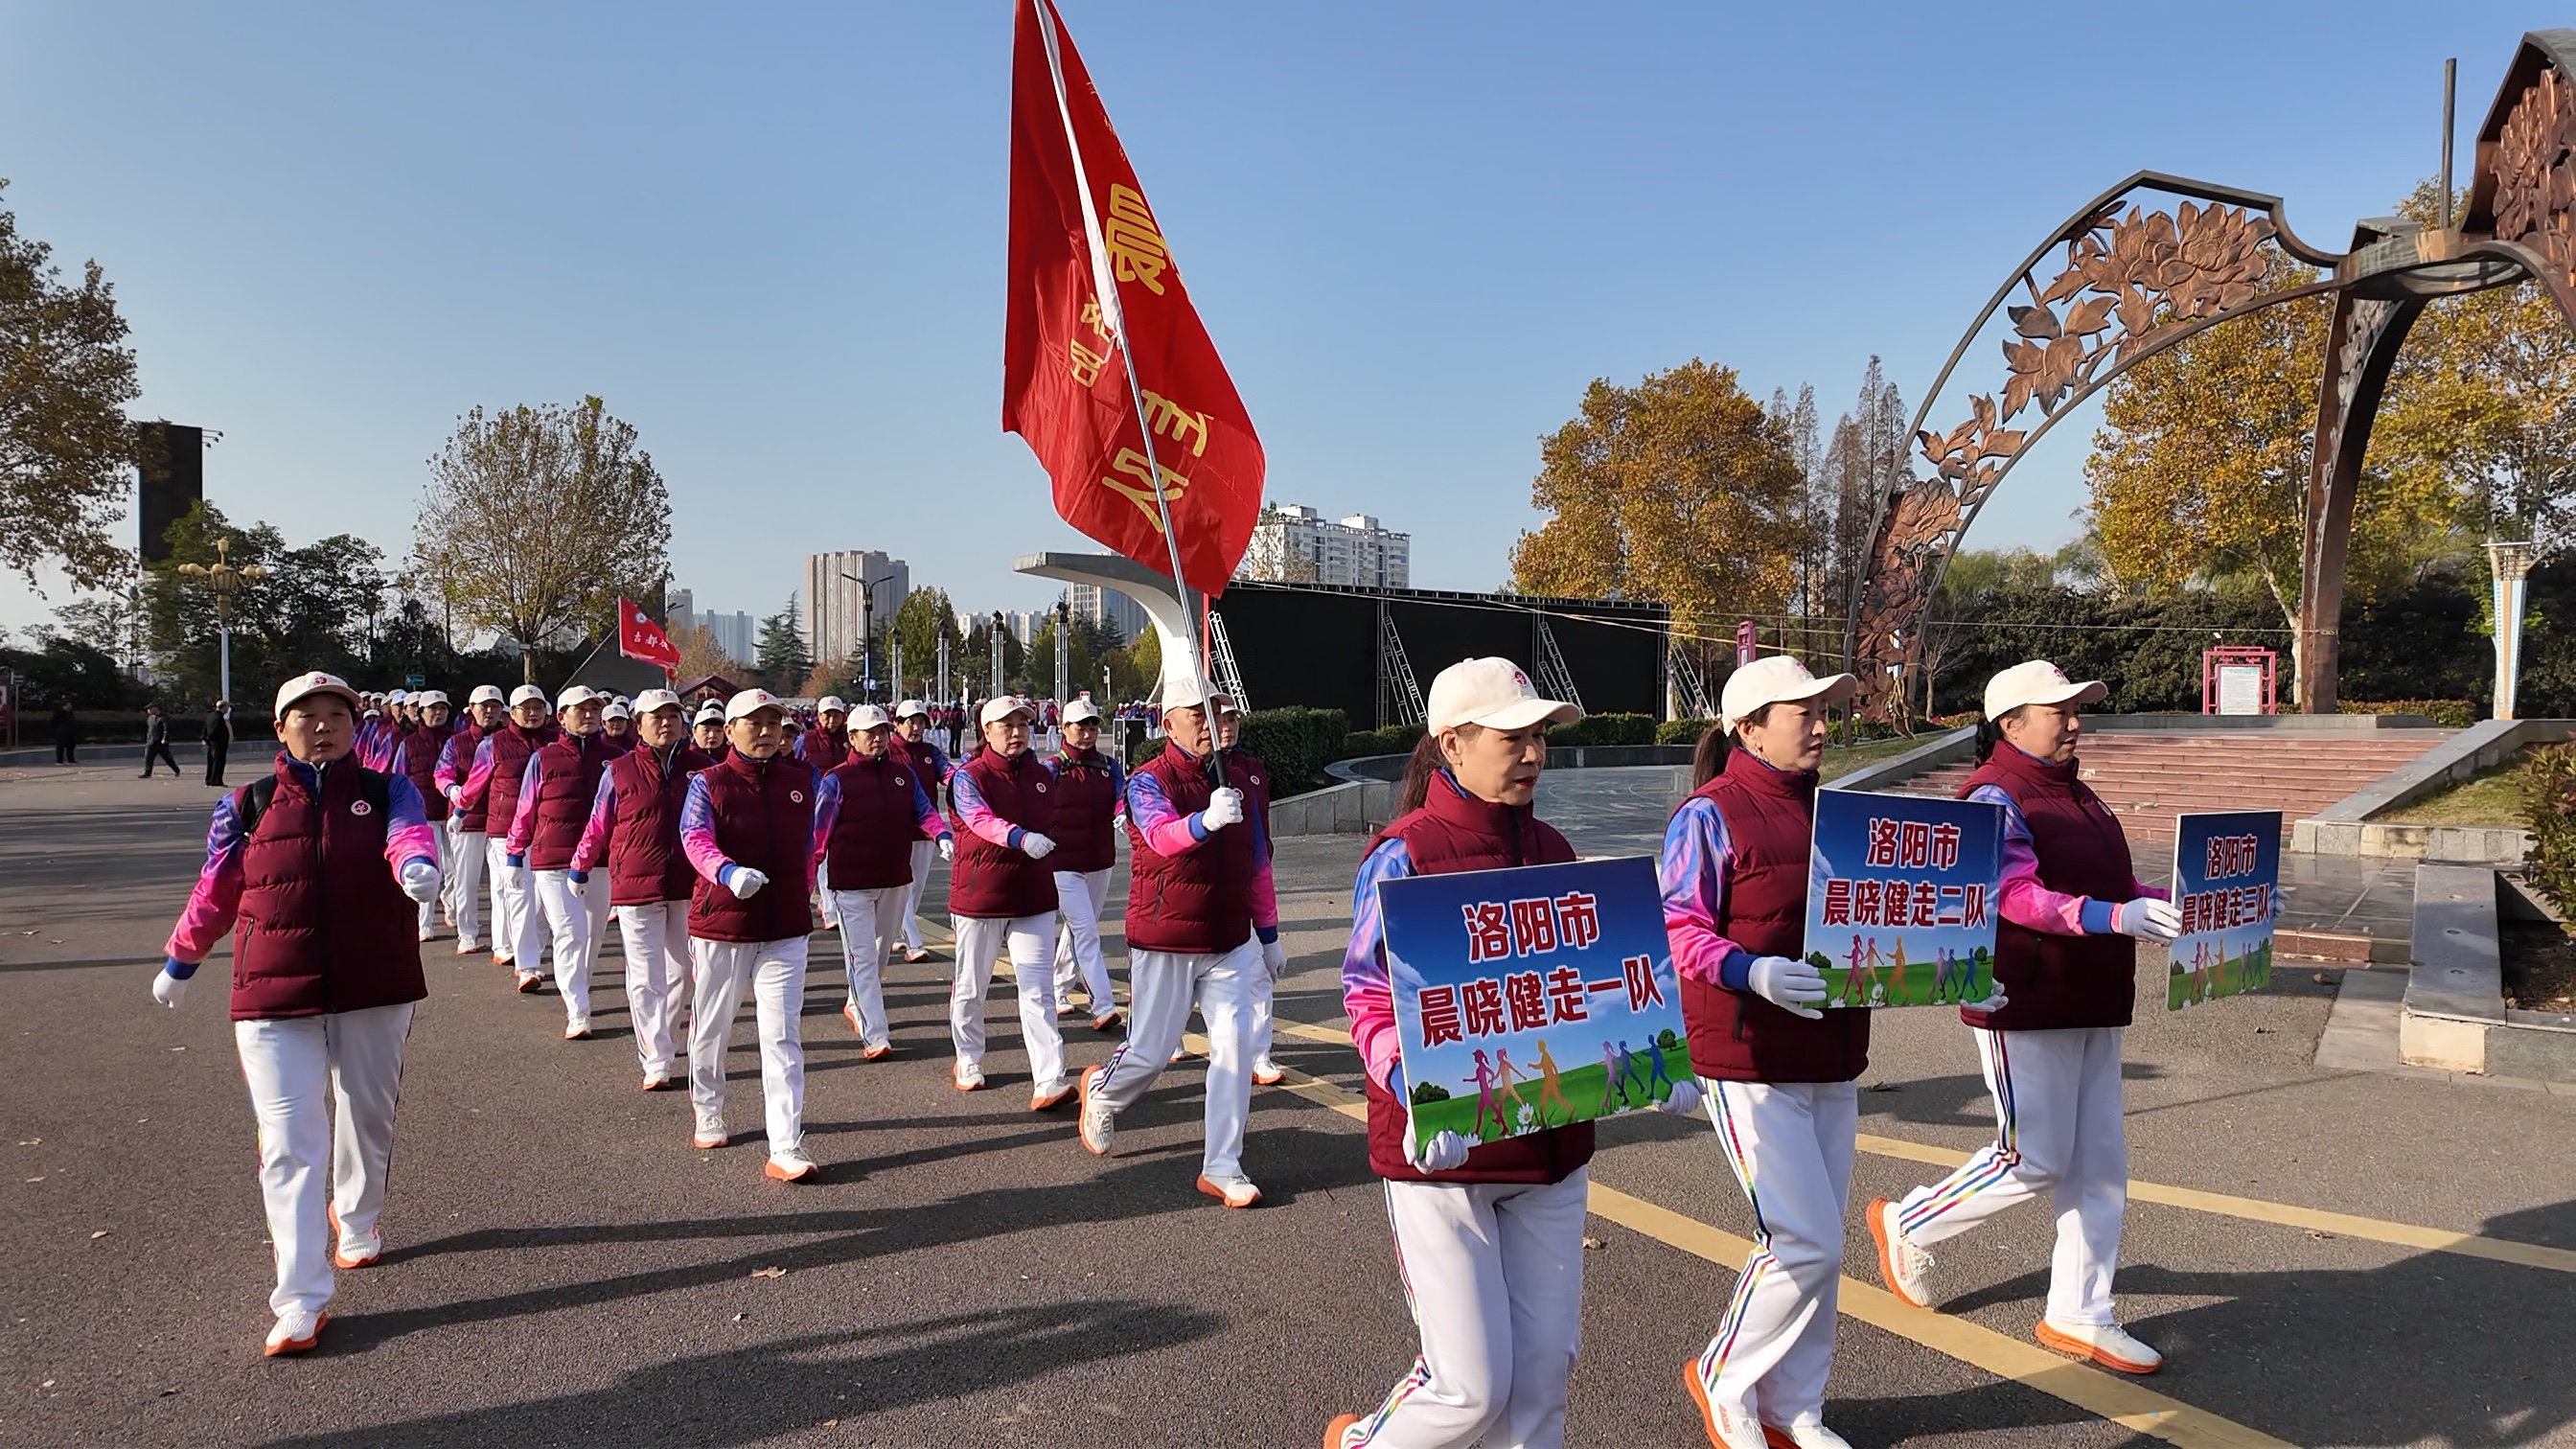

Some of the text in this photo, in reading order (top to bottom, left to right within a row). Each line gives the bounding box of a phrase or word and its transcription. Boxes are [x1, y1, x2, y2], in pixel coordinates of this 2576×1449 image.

[1867, 818, 1961, 869] 洛阳市
[2206, 834, 2257, 879] 洛阳市
[1462, 891, 1599, 963] 洛阳市
[1822, 878, 1988, 931] 晨晓健走二队
[2180, 884, 2270, 936] 晨晓健走三队
[1418, 955, 1664, 1048] 晨晓健走一队
